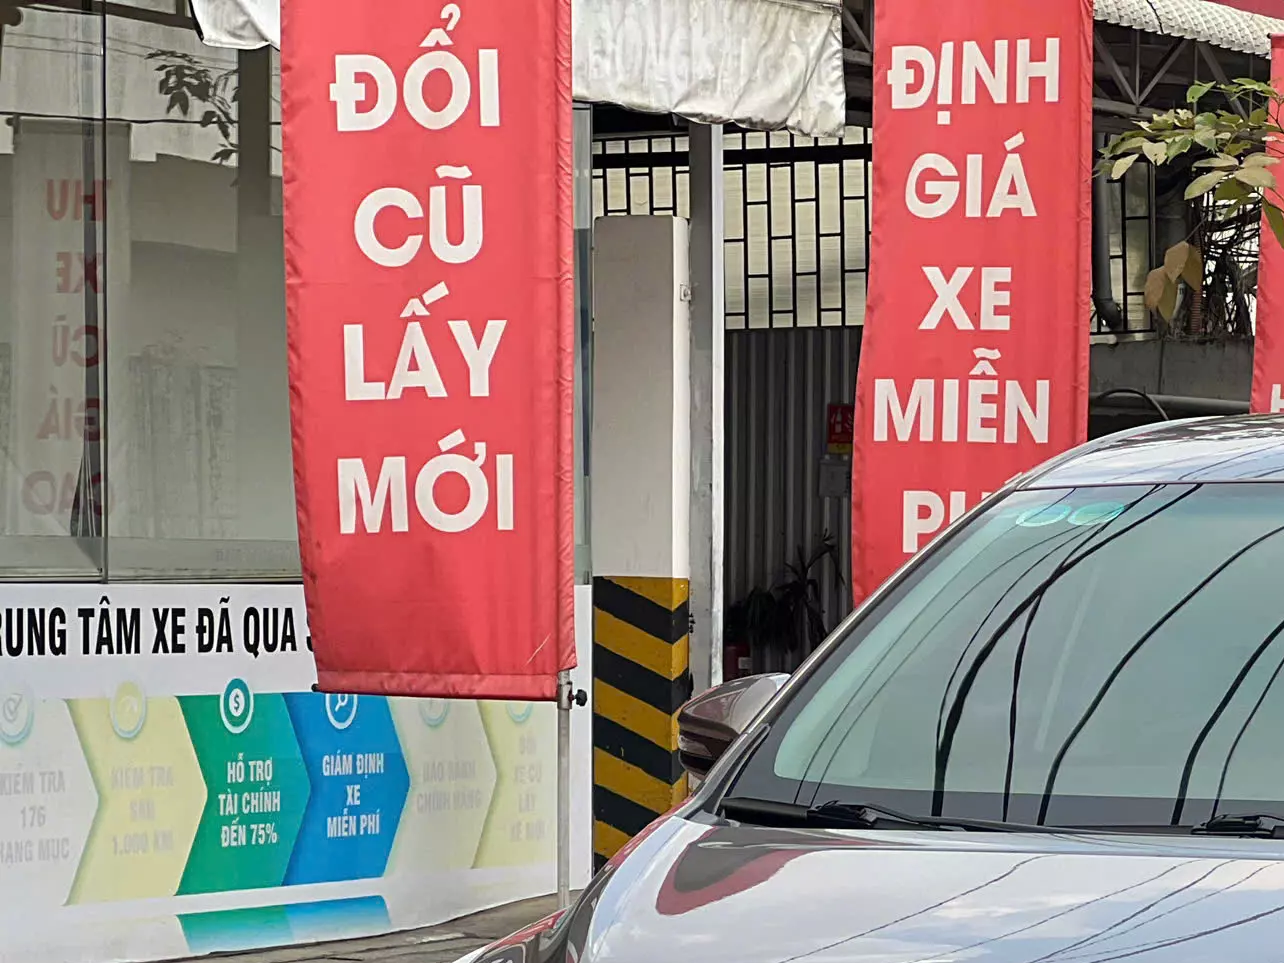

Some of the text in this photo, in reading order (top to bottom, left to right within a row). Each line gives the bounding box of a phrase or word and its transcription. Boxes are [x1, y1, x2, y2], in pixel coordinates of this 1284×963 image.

[329, 3, 501, 132] ĐỔI
[887, 37, 1060, 126] ĐỊNH
[905, 131, 1038, 219] GIÁ
[354, 165, 484, 268] CŨ
[919, 266, 1013, 331] XE
[343, 281, 507, 401] LẤY
[873, 348, 1050, 444] MIỄN
[337, 429, 514, 534] MỚI
[77, 596, 141, 655] TÂM
[152, 607, 186, 654] XE
[195, 596, 234, 653] ĐÃ
[243, 606, 298, 658] QUA
[227, 752, 273, 786] HỖ TRỢ
[322, 749, 384, 779] GIÁM ĐỊNH
[346, 784, 361, 806] XE
[20, 804, 46, 831] 176
[218, 786, 281, 816] TÀI CHÍNH
[221, 817, 278, 847] ĐẾN 75%
[327, 808, 380, 838] MIỄN PHÍ
